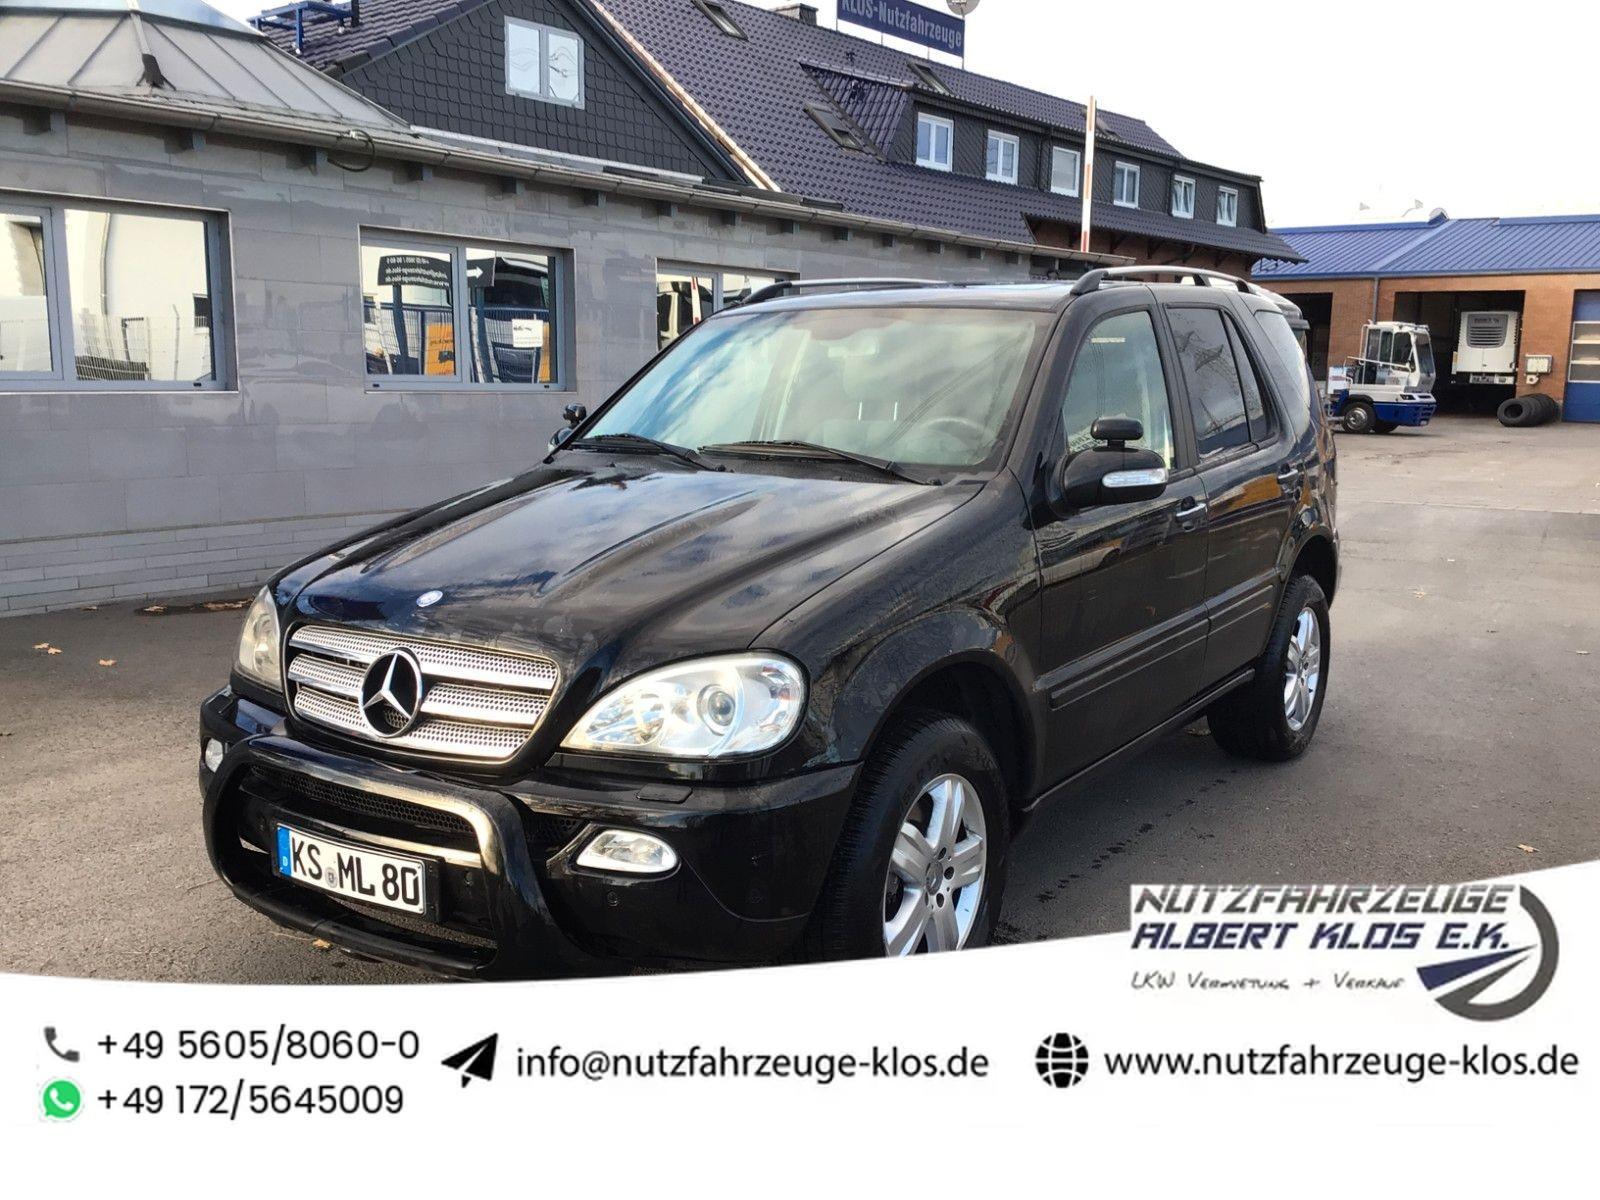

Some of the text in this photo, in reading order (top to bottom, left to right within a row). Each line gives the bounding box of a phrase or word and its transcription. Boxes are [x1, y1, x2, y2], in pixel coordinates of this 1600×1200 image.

[841, 0, 962, 49] KLOS-Nutzfahrzeuge
[291, 837, 420, 906] KS ML 80
